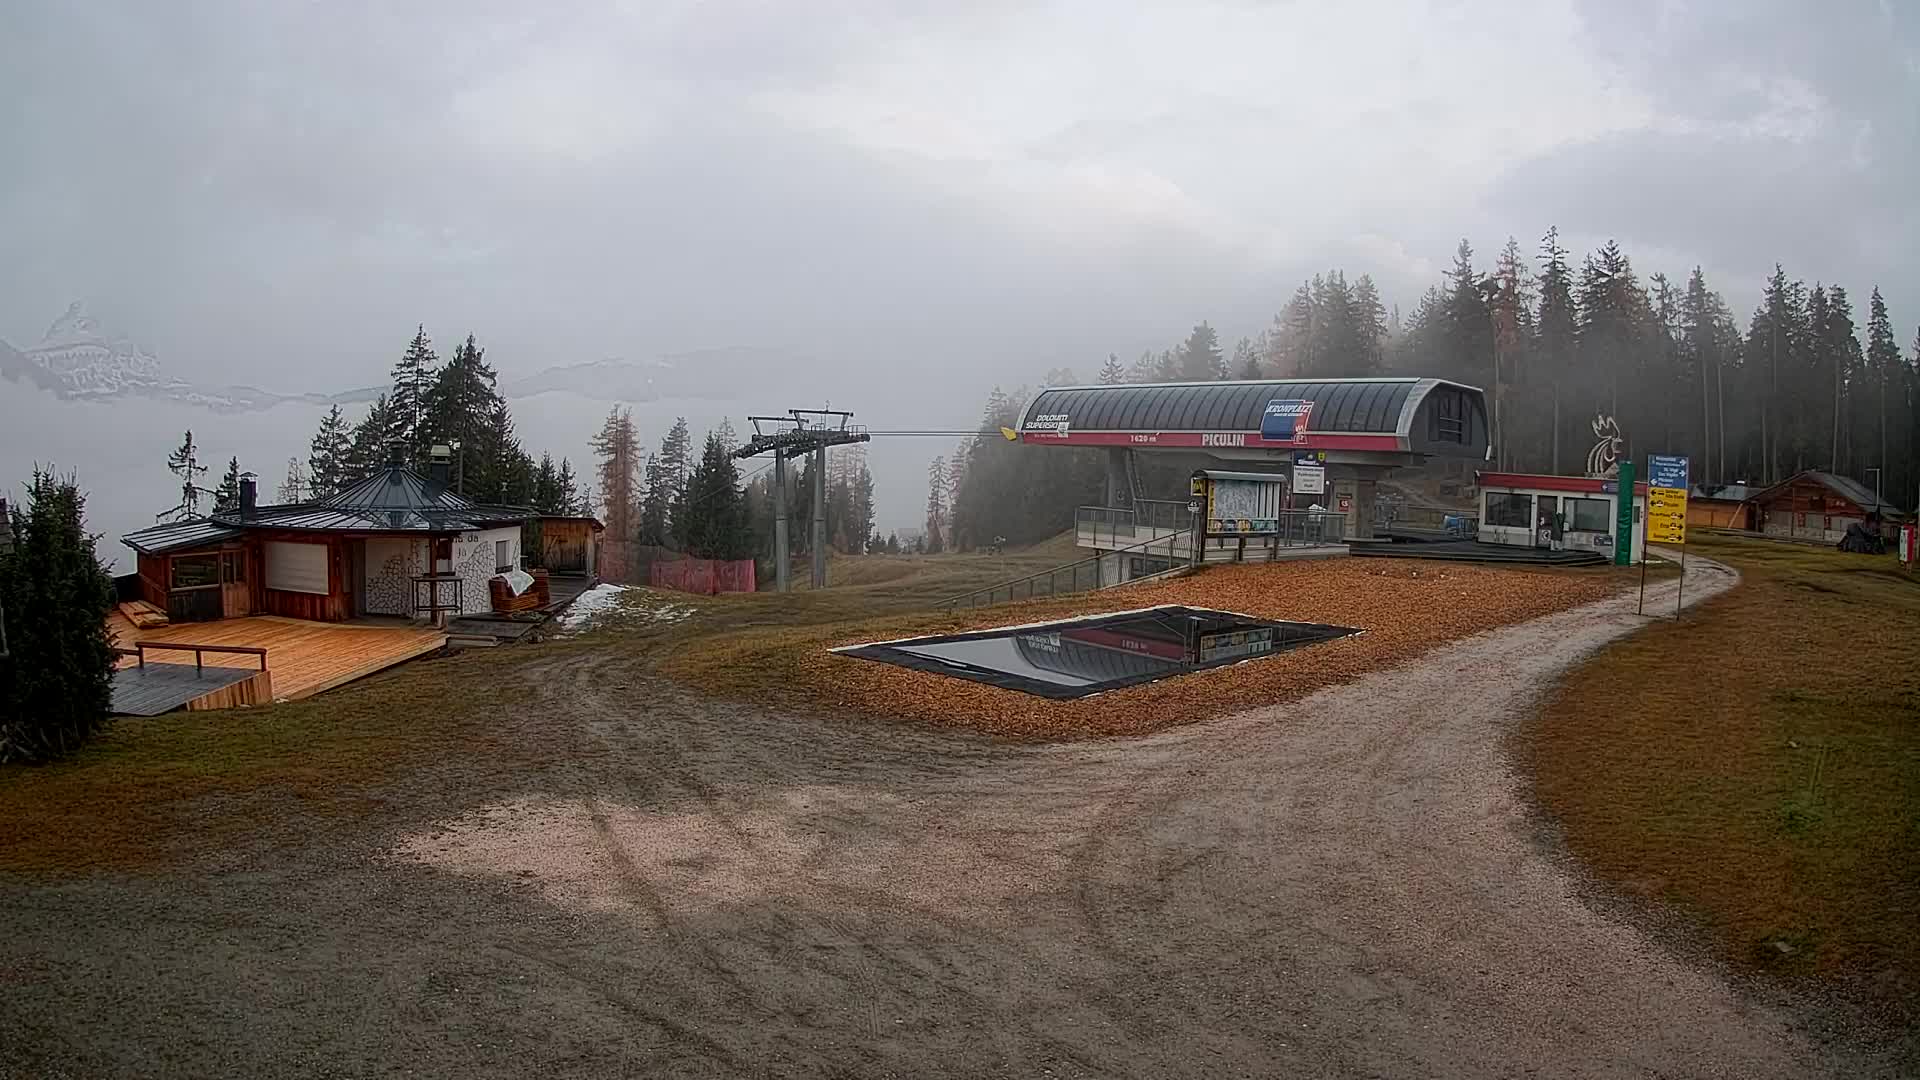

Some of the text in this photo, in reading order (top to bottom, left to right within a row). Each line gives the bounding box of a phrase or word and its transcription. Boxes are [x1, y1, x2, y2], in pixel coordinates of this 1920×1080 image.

[1266, 404, 1312, 413] KRONPLATZ
[1036, 414, 1068, 422] DOLOMITI
[1025, 421, 1058, 429] SUPERSKI
[1130, 434, 1148, 443] 1620
[1201, 433, 1245, 447] PICULIN
